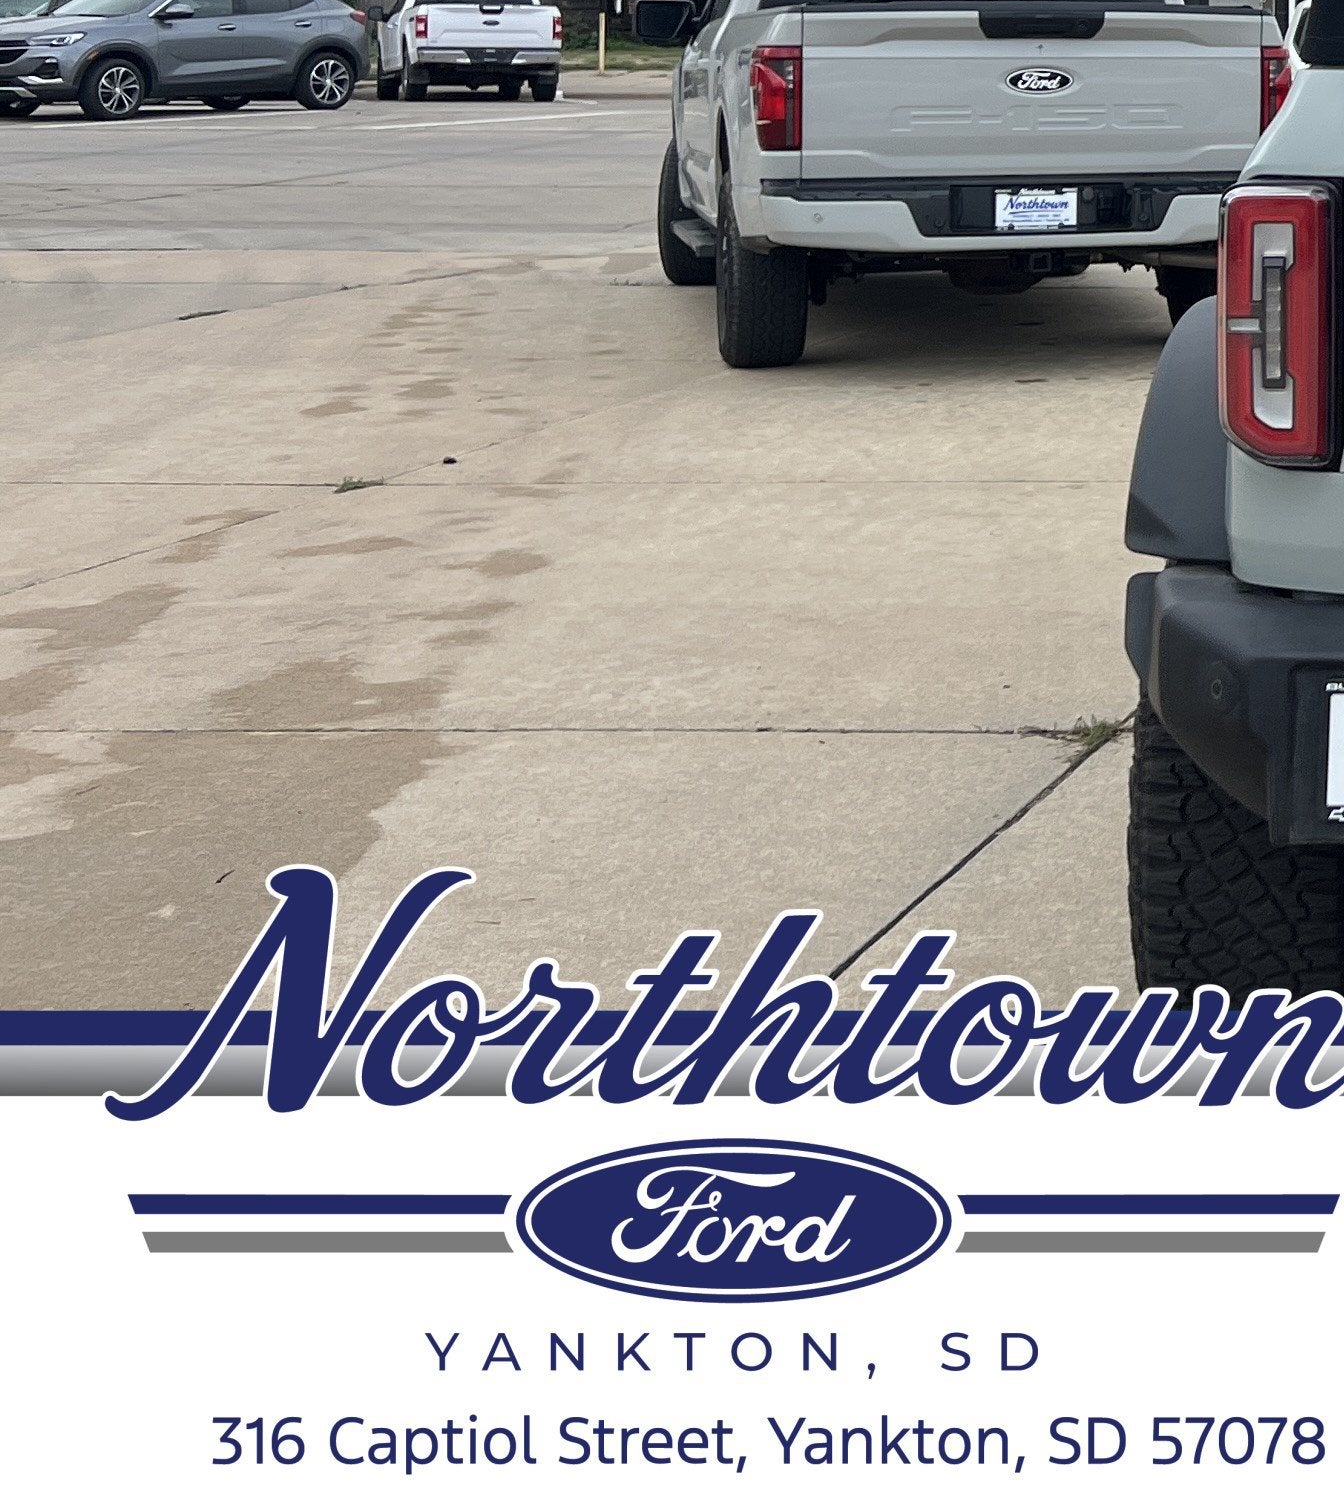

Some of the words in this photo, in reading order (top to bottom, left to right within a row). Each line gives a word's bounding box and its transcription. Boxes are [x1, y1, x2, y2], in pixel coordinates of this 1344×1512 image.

[1017, 72, 1061, 90] Ford
[891, 103, 1186, 132] F-150
[1003, 193, 1070, 211] Northtown
